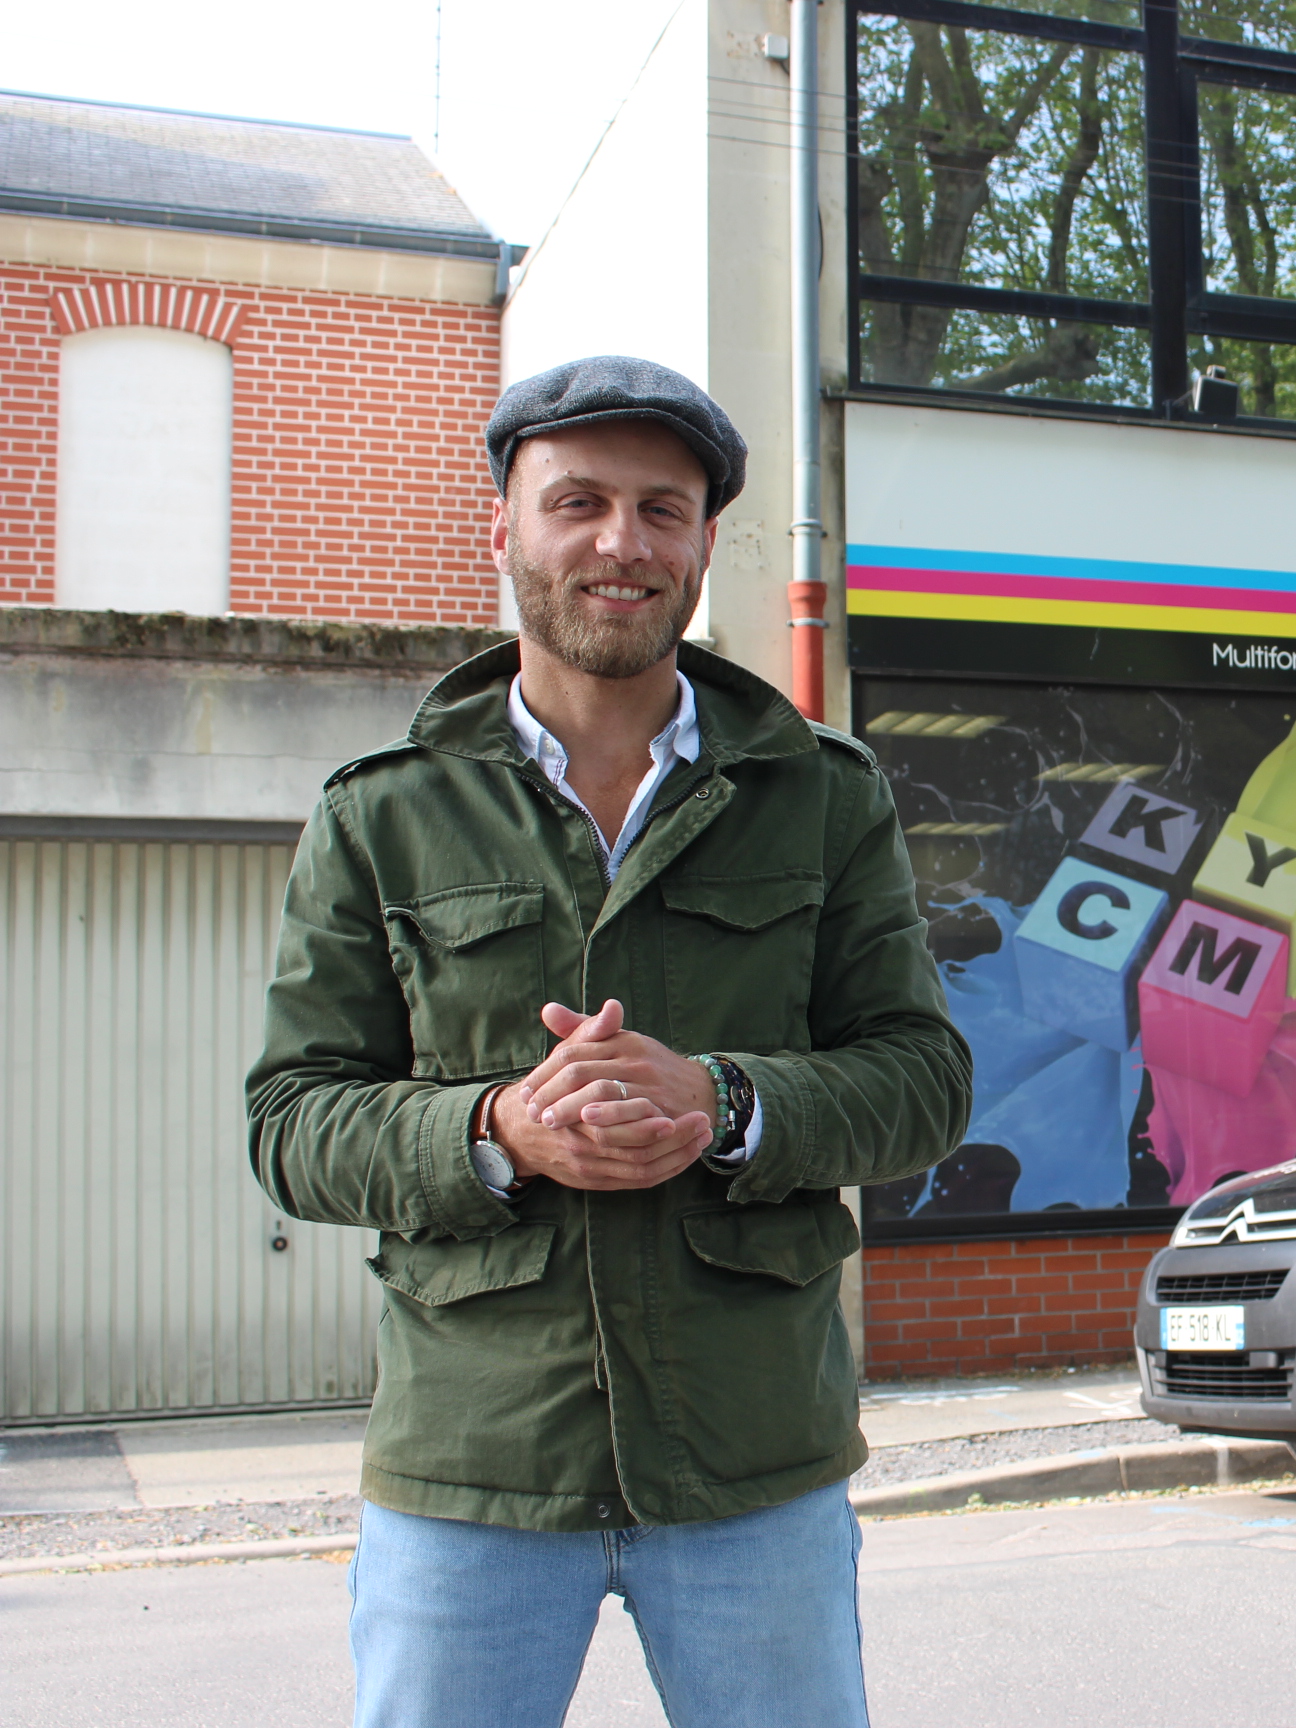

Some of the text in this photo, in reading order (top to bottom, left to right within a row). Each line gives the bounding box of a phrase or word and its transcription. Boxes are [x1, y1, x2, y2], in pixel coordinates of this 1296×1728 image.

[1107, 794, 1187, 852] K
[1056, 880, 1263, 997] C M
